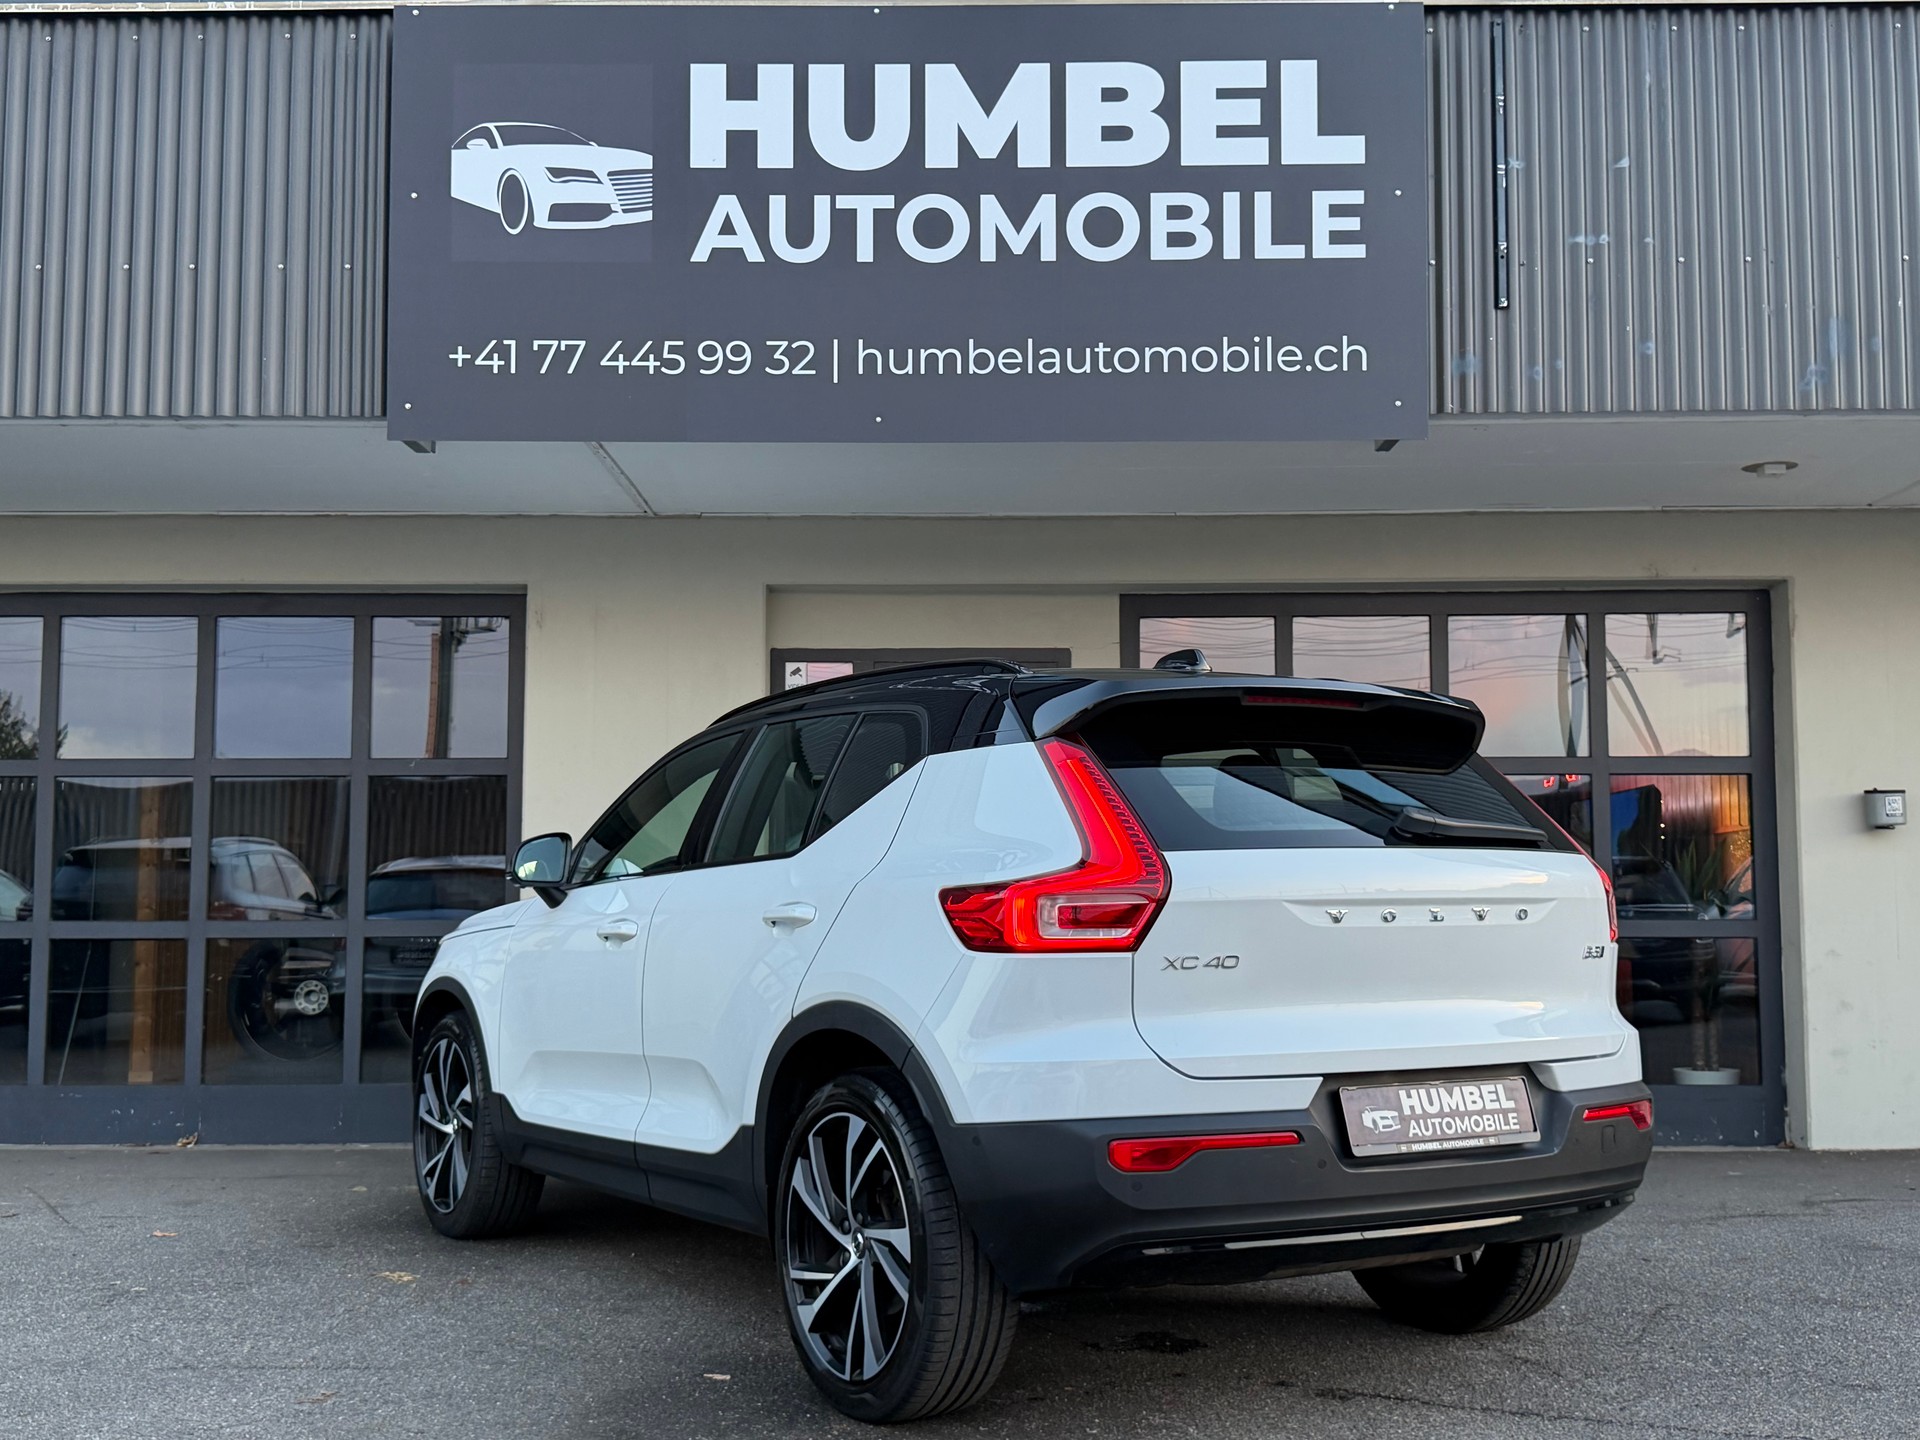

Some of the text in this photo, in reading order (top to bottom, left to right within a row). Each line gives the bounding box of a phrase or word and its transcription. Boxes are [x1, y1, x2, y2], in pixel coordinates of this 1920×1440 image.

[690, 59, 1365, 171] HUMBEL
[690, 189, 1366, 264] AUTOMOBILE
[448, 339, 517, 374] +41
[532, 340, 586, 374] 77
[600, 340, 686, 375] 445
[697, 340, 752, 375] 99
[764, 340, 816, 375] 32
[857, 335, 1367, 375] humbelautomobile.ch
[1325, 906, 1529, 924] VOLVO
[1398, 1083, 1516, 1116] HUMBEL
[1408, 1112, 1520, 1138] AUTOMOBILE
[1411, 1138, 1484, 1151] HUMBEL AUTOMOBILE
